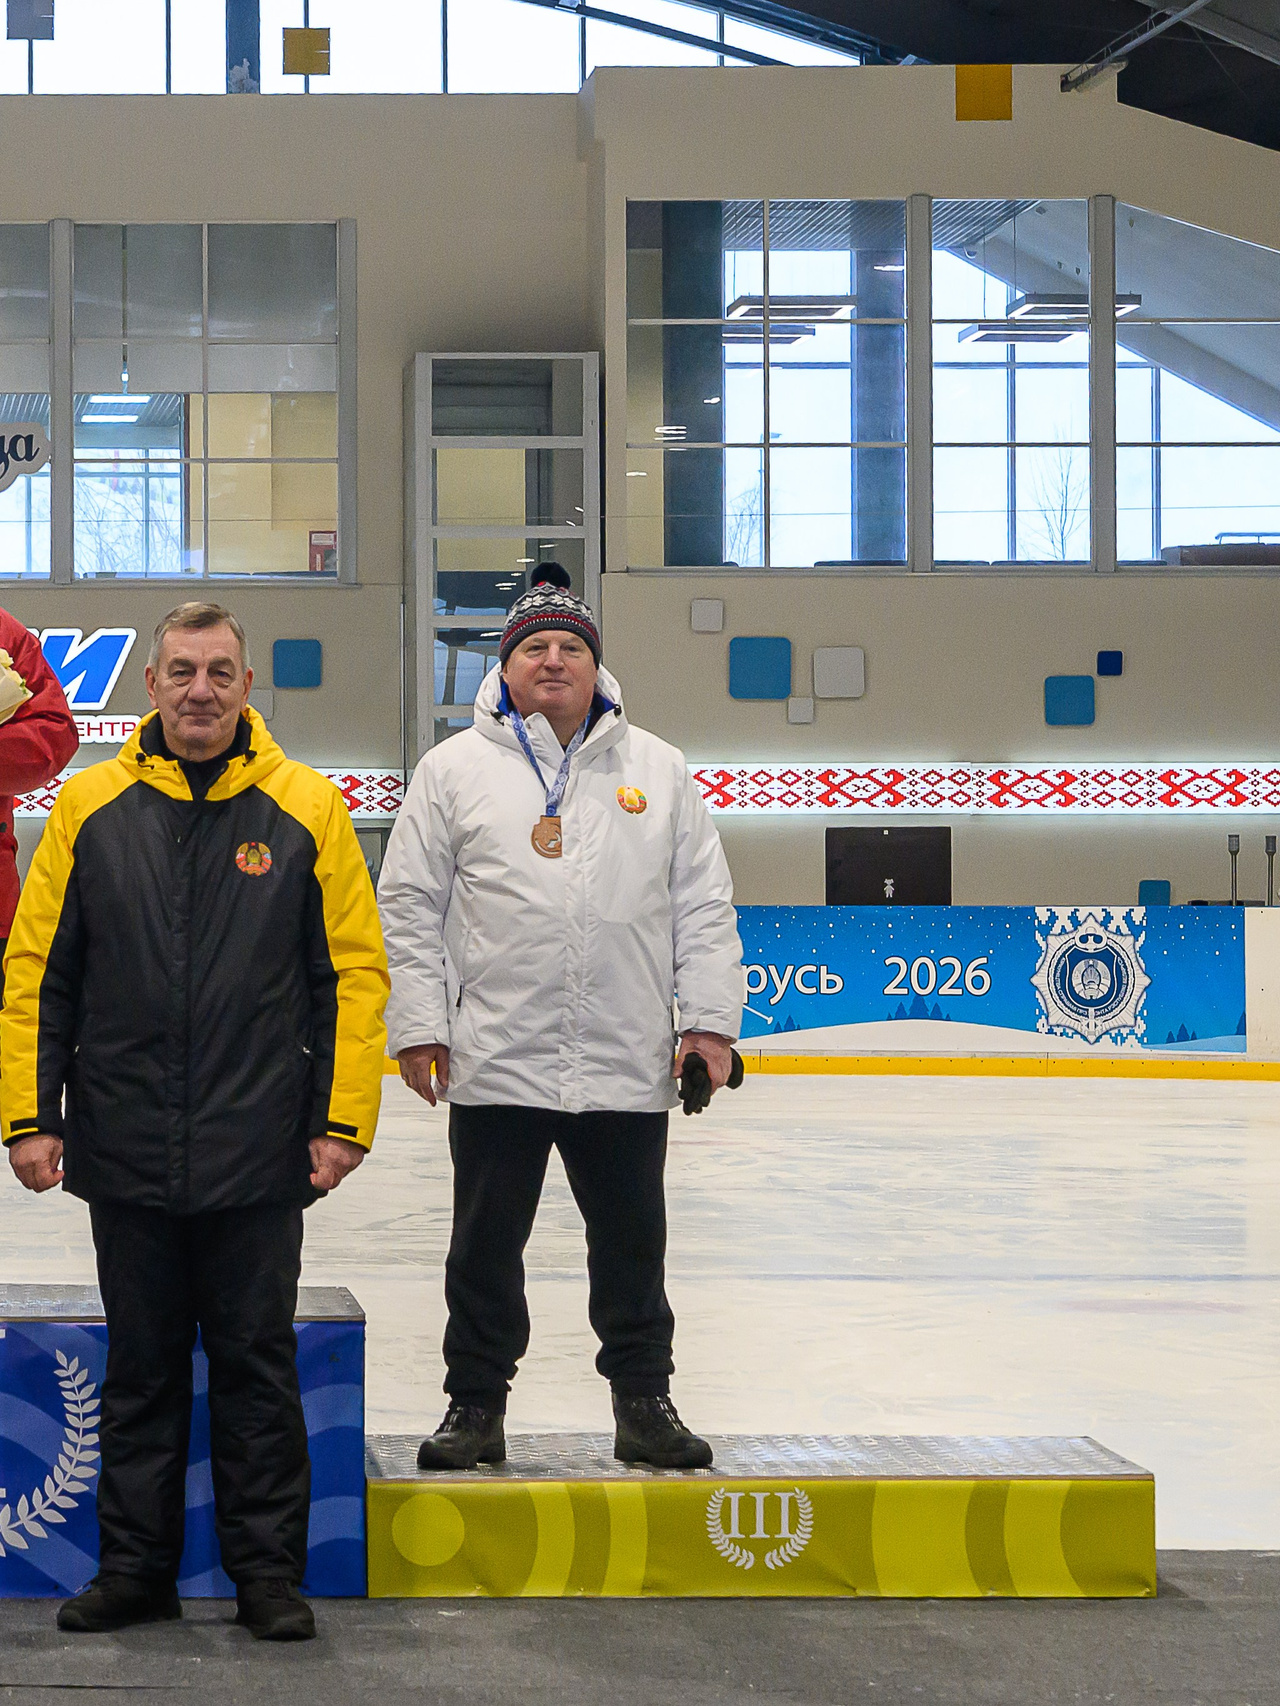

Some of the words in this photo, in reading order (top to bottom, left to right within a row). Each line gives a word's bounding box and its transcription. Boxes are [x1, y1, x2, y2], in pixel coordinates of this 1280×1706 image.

[741, 964, 844, 1006] русь
[883, 956, 992, 996] 2026
[724, 1492, 796, 1539] III
